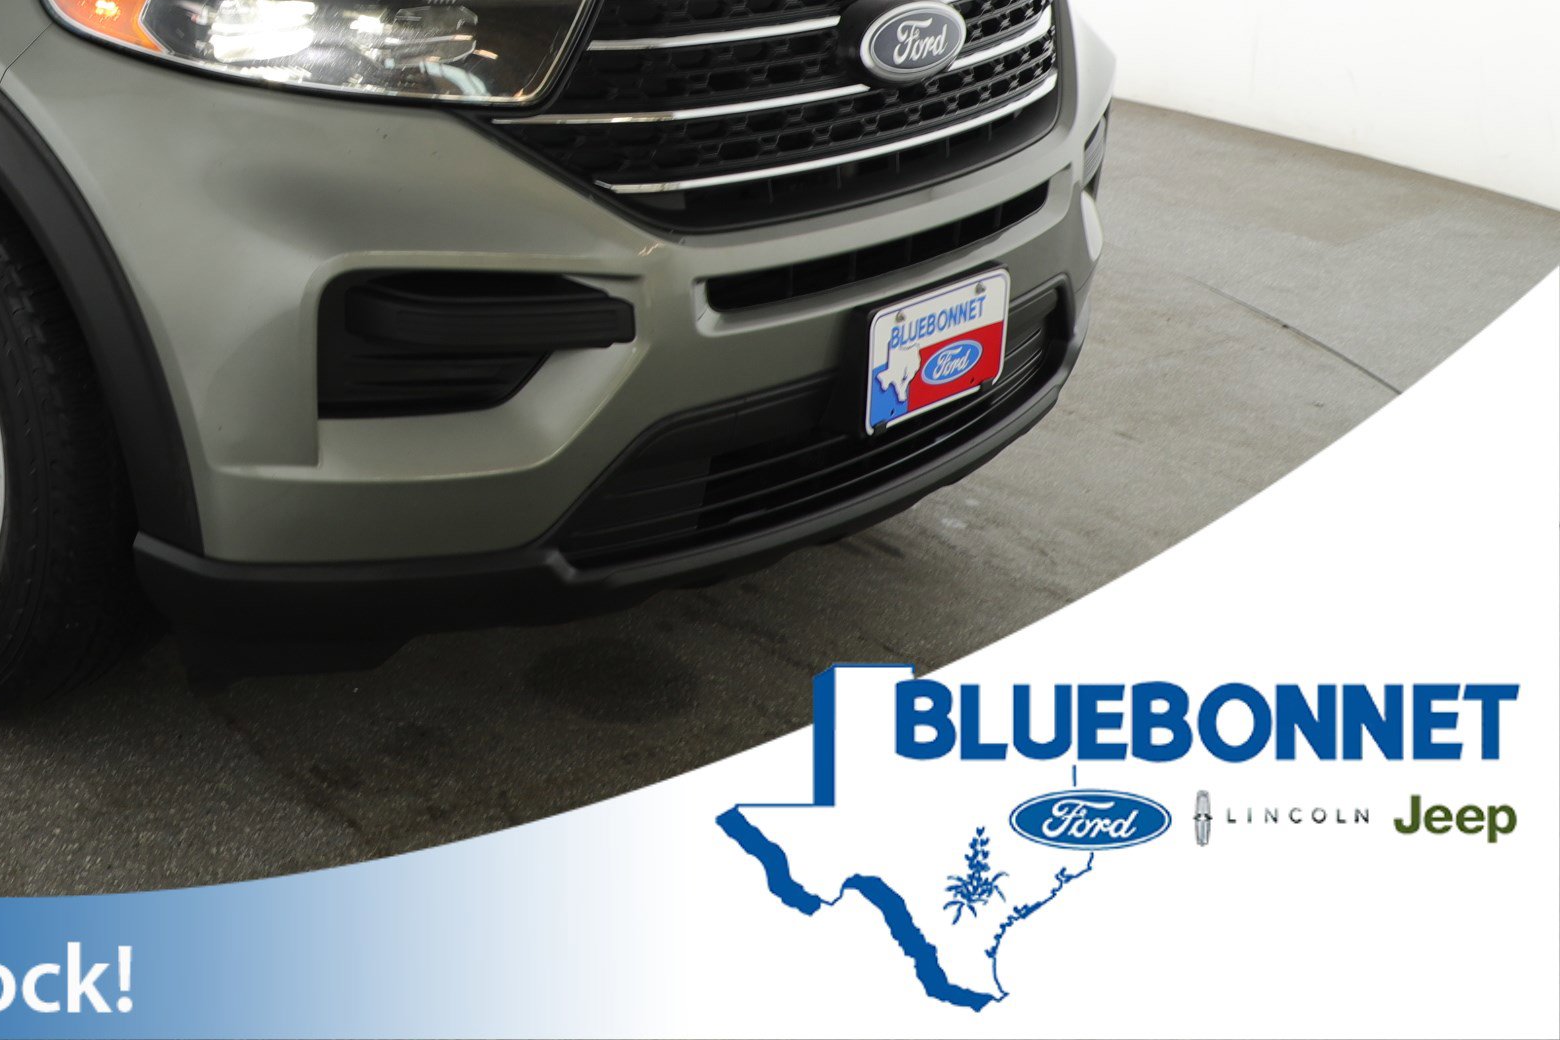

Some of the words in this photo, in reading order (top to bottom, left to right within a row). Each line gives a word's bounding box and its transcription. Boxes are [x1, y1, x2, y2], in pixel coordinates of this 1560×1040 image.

[893, 17, 948, 65] Ford
[889, 295, 986, 349] BLUEBONNET
[932, 346, 972, 380] Ford
